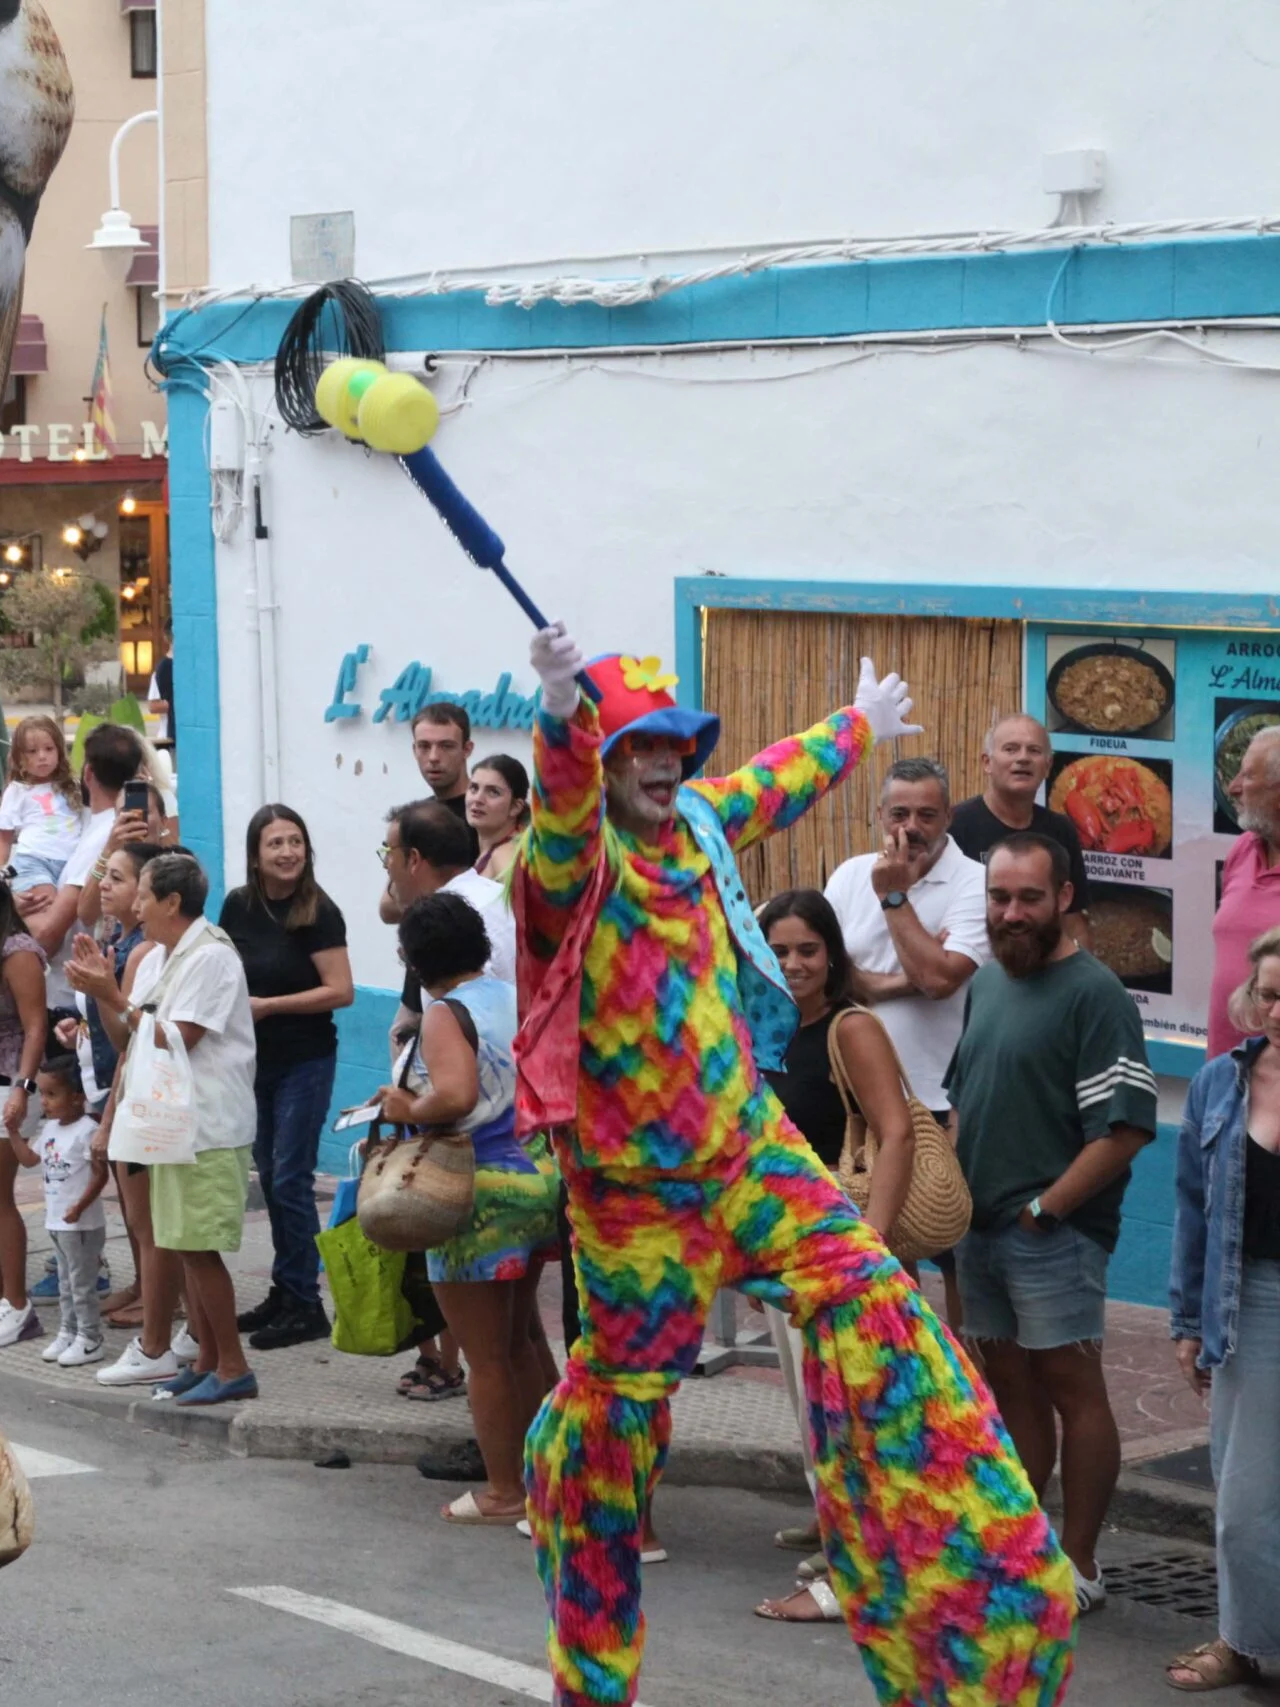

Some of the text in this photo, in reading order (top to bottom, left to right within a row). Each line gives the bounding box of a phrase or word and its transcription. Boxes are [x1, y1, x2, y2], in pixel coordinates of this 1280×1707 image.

[1084, 853, 1143, 868] ARROZ CON
[1084, 866, 1145, 880] BOGAVANTE
